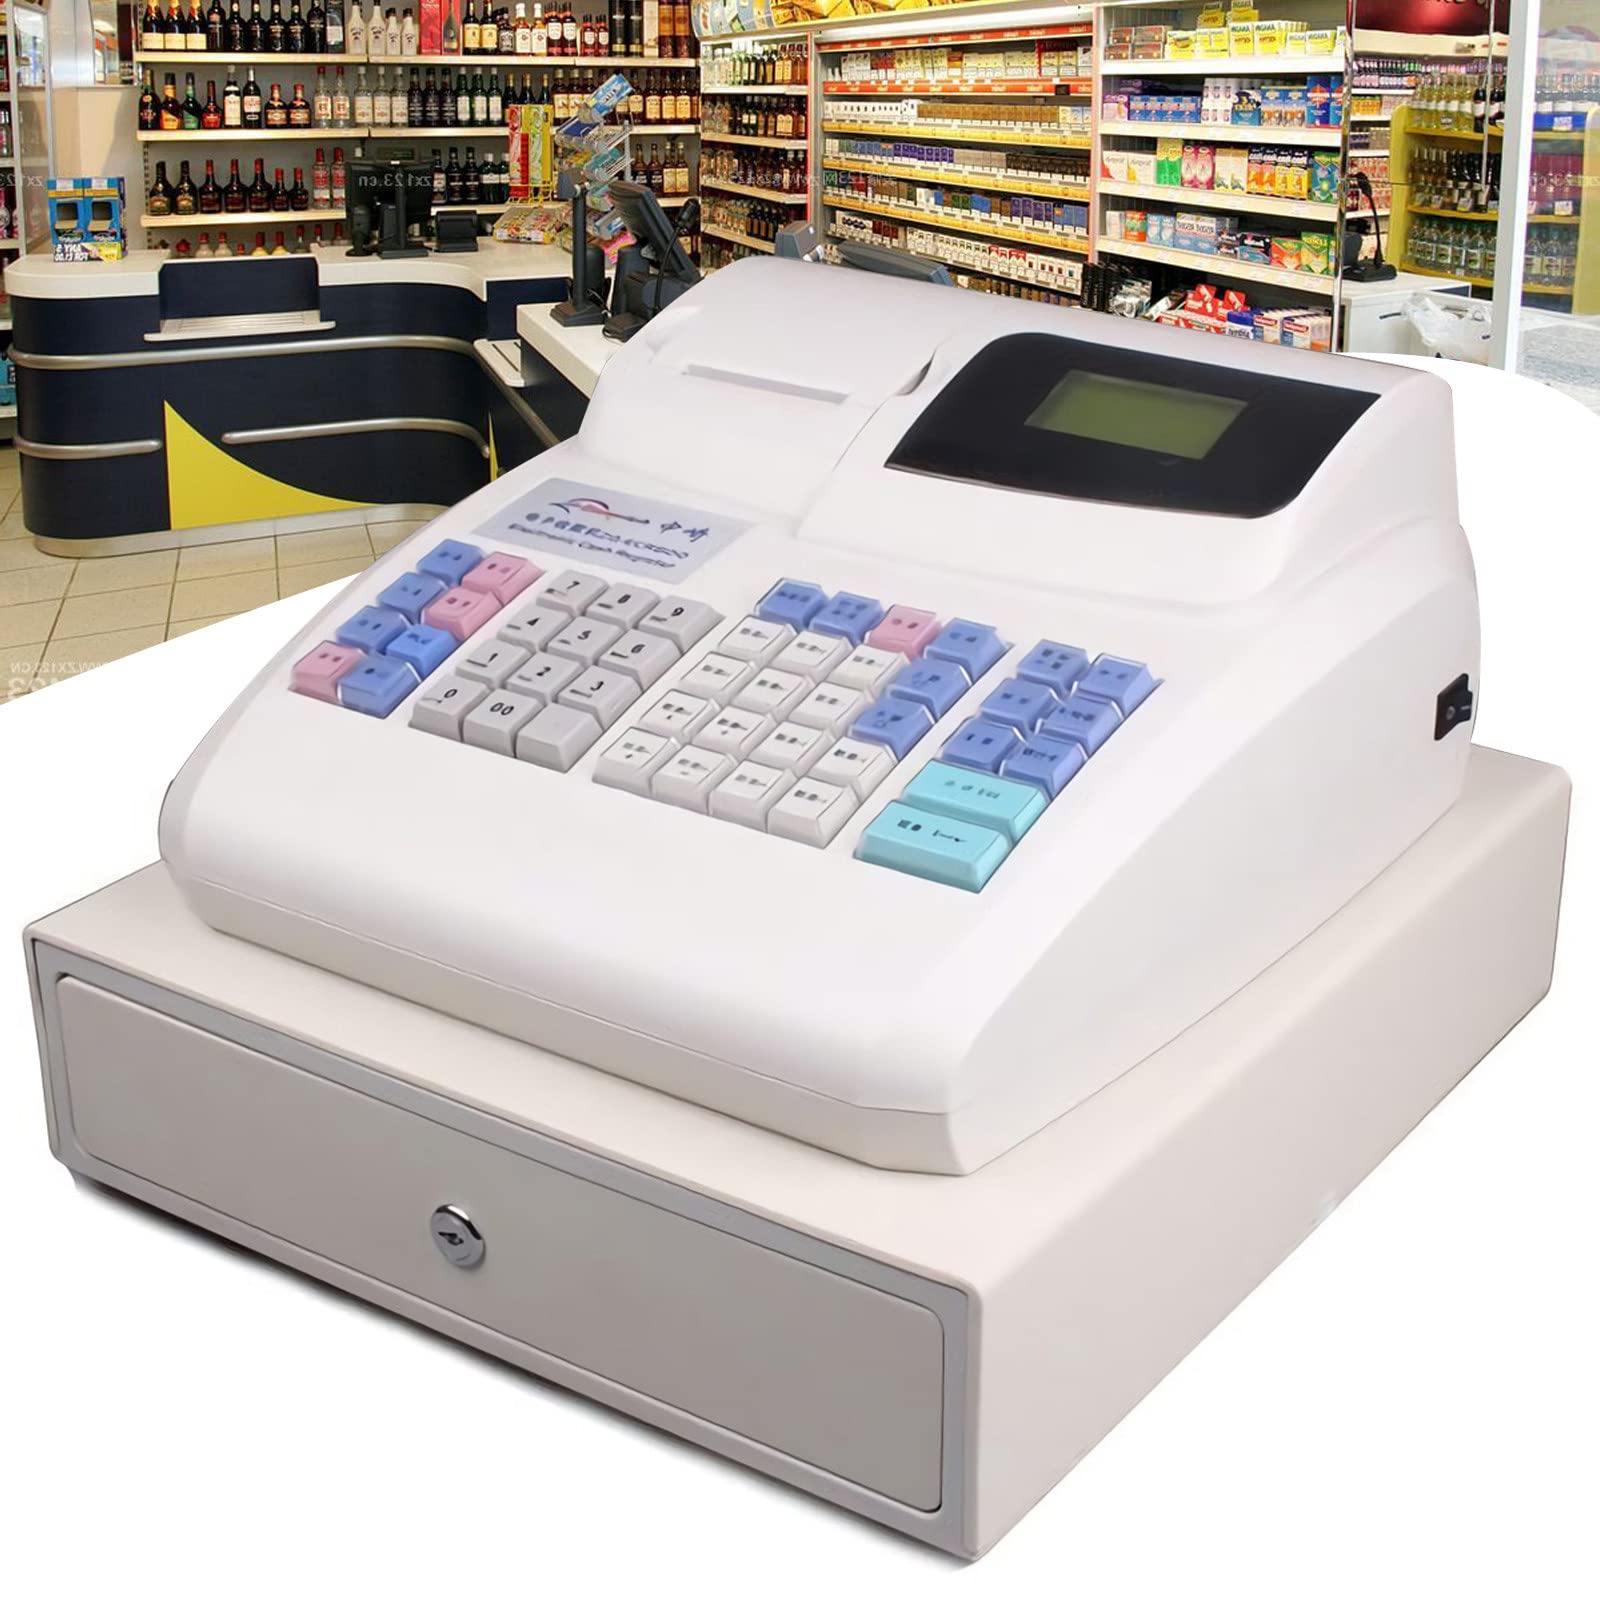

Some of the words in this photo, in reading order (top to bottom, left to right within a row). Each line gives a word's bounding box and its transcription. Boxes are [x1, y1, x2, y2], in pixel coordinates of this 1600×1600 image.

[566, 580, 581, 591] 7
[671, 606, 685, 618] 9
[536, 666, 551, 677] 2
[444, 688, 457, 701] 0
[490, 701, 514, 716] 00
